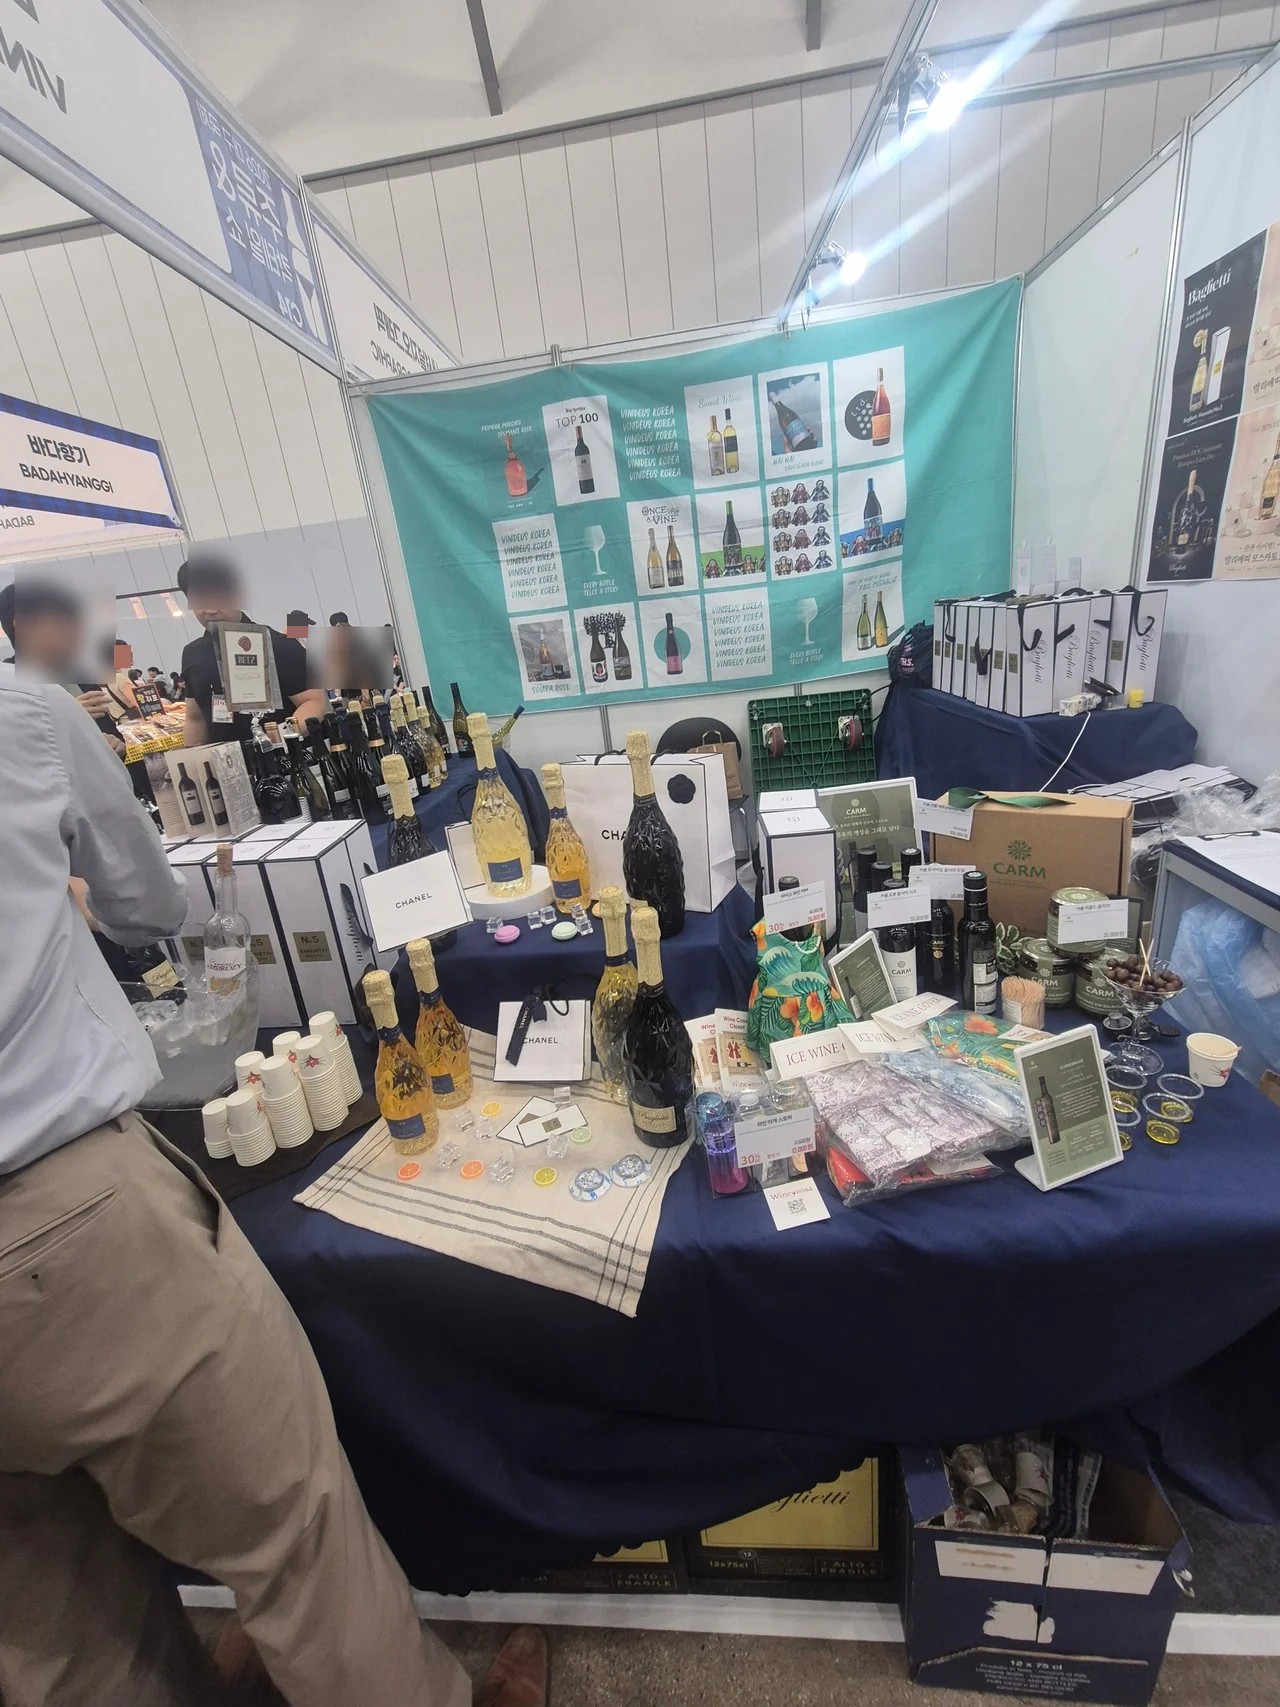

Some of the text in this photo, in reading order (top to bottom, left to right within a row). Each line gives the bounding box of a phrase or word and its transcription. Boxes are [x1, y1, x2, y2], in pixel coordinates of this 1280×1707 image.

[1188, 267, 1232, 307] Baglietti
[555, 413, 599, 428] TOP 100
[26, 434, 91, 467] 바다향기
[19, 463, 114, 494] BADAHYANGGI
[641, 506, 667, 516] ONCE
[652, 514, 678, 525] VINE
[845, 807, 867, 816] CARM
[871, 826, 888, 834] 그대로
[993, 862, 1046, 879] CARM
[395, 892, 432, 909] CHANEL
[1085, 986, 1114, 997] CARM
[519, 1006, 530, 1029] CHANEL
[786, 1042, 840, 1066] ICE WINE
[709, 1560, 749, 1570] 12x75cl
[820, 1567, 877, 1575] FRAGILE
[617, 1580, 671, 1588] FRAGILE
